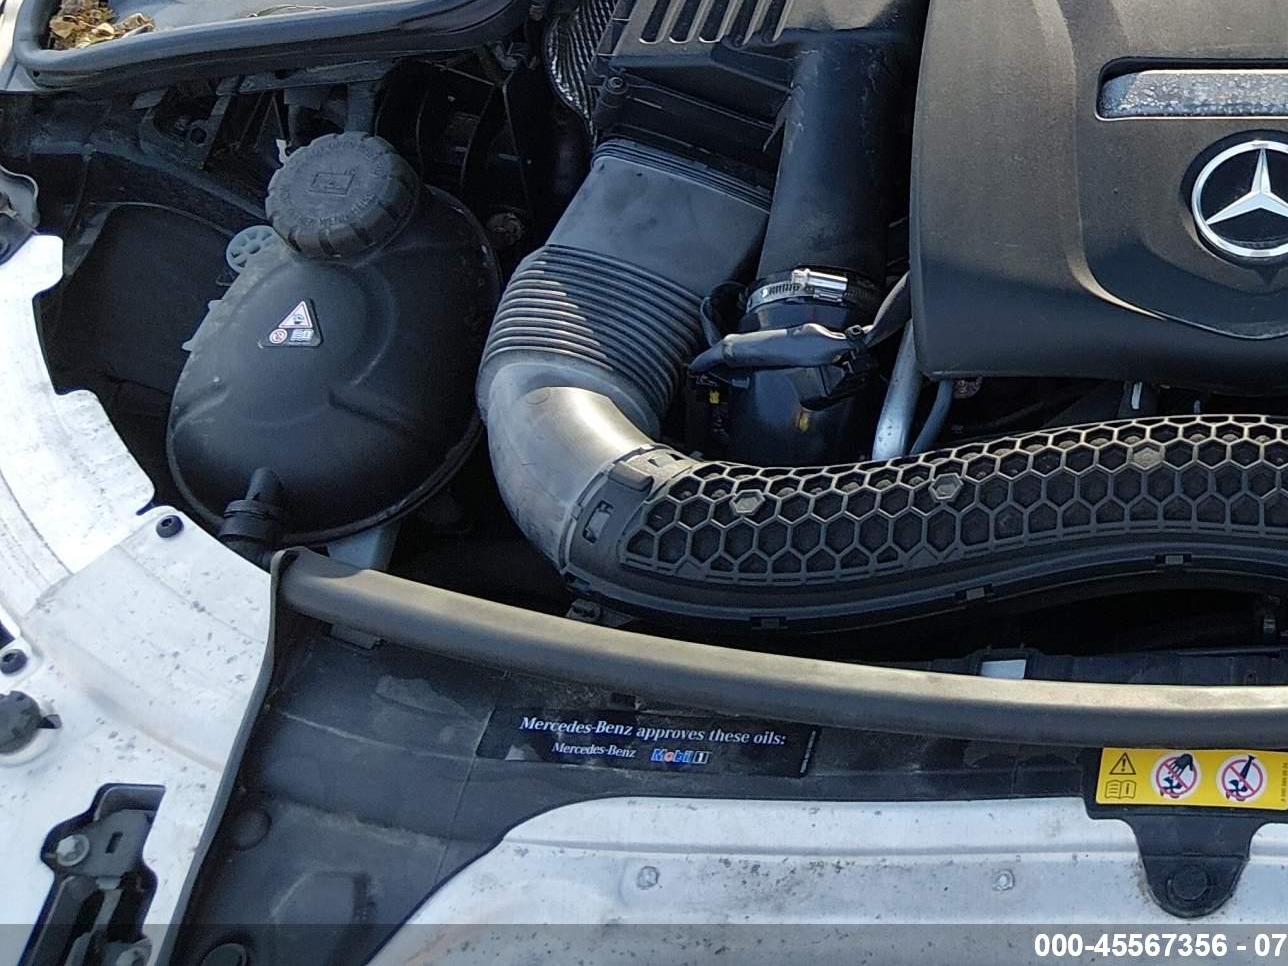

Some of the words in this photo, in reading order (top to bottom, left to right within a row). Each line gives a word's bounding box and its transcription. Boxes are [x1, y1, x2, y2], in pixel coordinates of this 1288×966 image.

[519, 716, 633, 736] Mercedes-Benz
[636, 726, 705, 741] approves
[708, 728, 750, 743] these
[753, 730, 786, 745] oils:
[552, 742, 637, 758] Mercedes-Benz
[650, 748, 693, 763] Mobil
